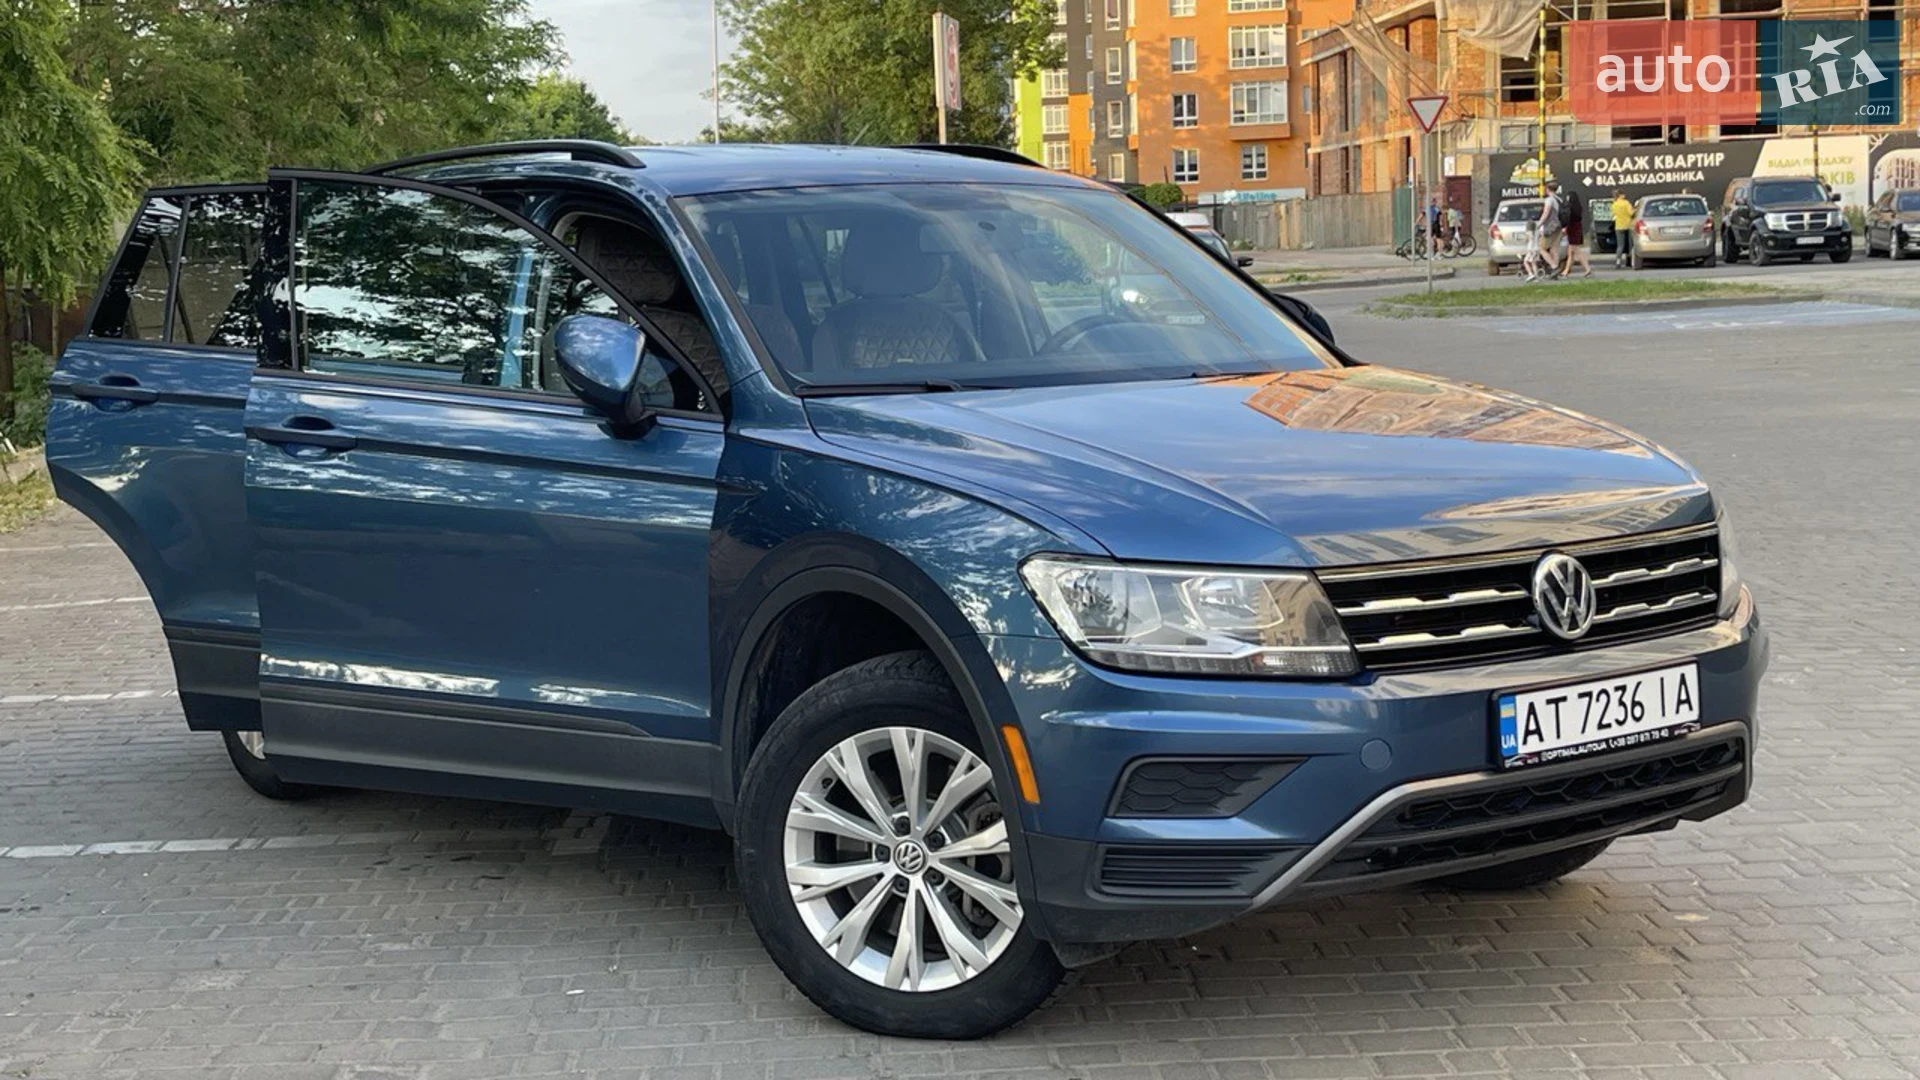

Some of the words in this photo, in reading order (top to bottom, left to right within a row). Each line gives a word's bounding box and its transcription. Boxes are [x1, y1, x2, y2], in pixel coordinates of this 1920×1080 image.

[1574, 156, 1650, 174] ПРОДАЖ
[1654, 152, 1725, 170] КВАРТИР
[1596, 175, 1616, 186] ВІД
[1618, 170, 1704, 185] ЗАБУДОВНИКА
[1502, 186, 1562, 198] MILLENNM
[1522, 695, 1568, 746] AT
[1577, 681, 1645, 735] 7236
[1659, 672, 1693, 717] IA
[1501, 734, 1517, 749] UA
